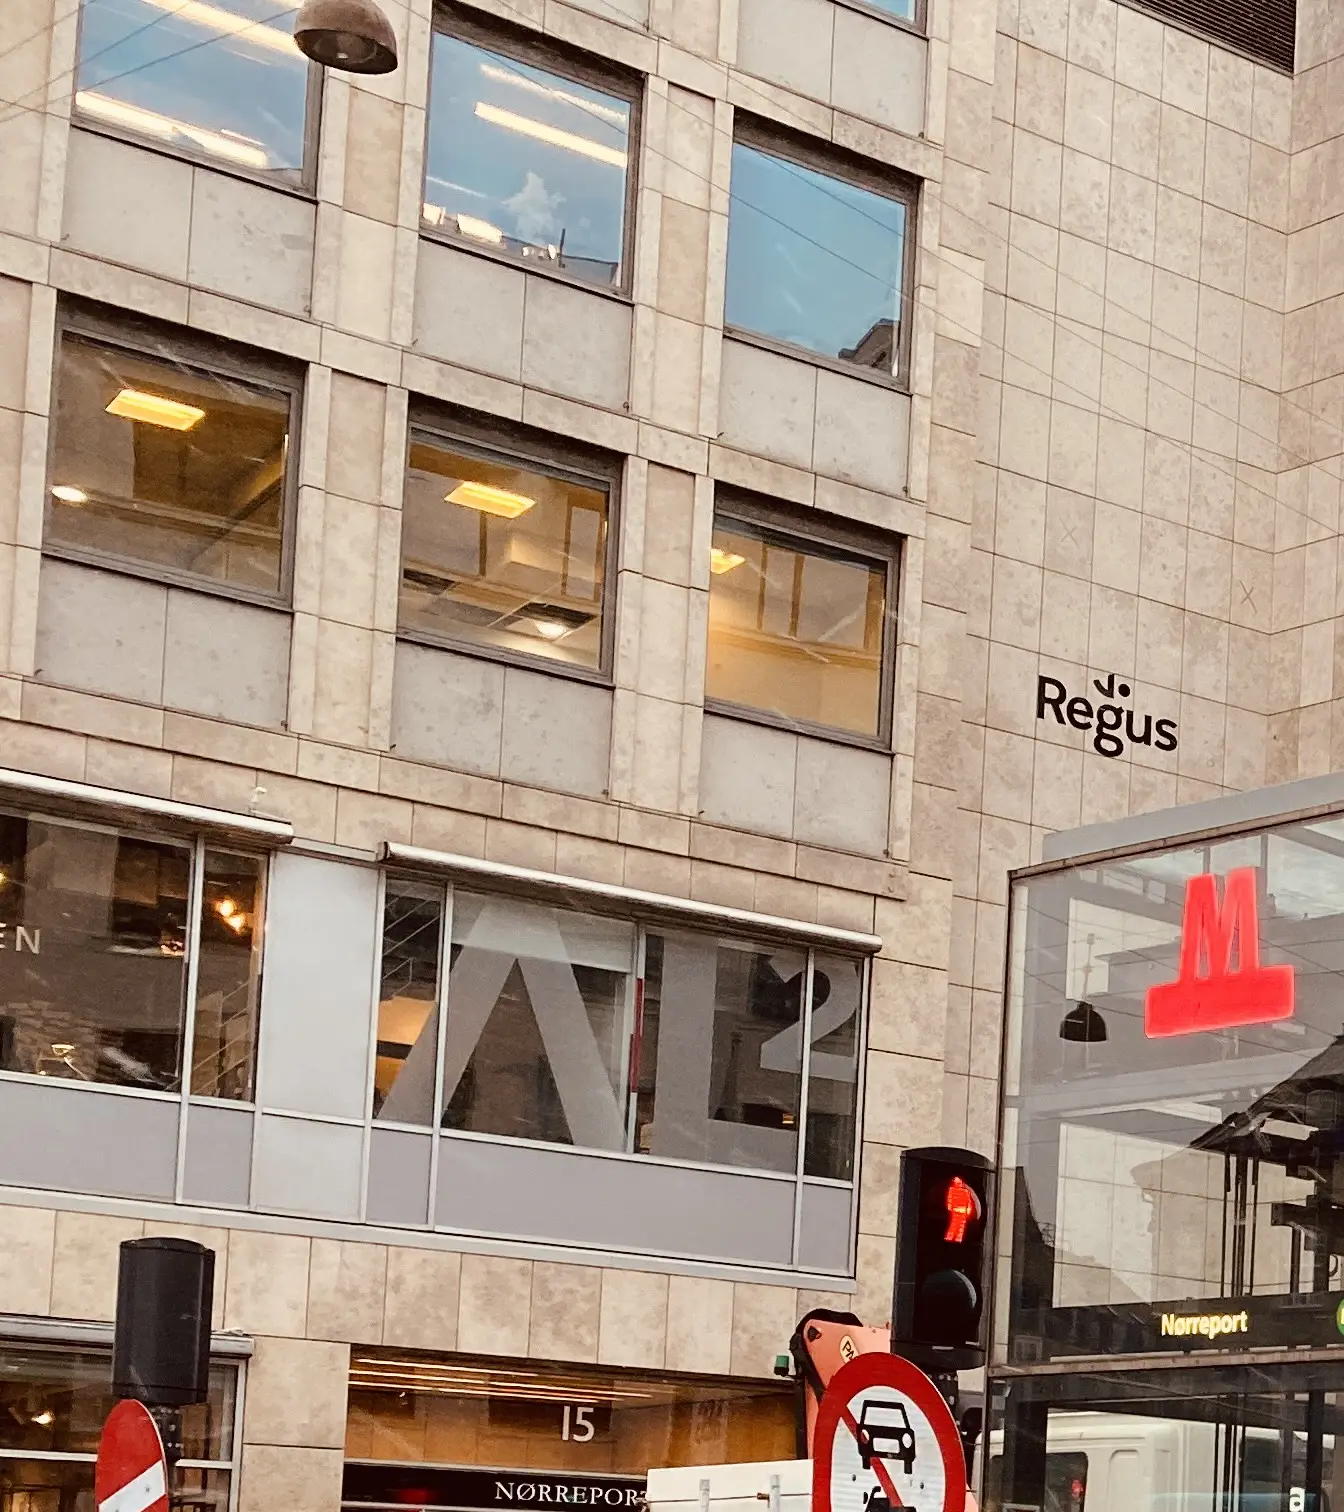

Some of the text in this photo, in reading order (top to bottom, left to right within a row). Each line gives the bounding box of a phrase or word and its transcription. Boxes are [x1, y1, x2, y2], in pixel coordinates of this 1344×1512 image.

[1036, 673, 1178, 758] Regus
[1161, 1310, 1249, 1340] Nørreport
[561, 1405, 595, 1443] 15
